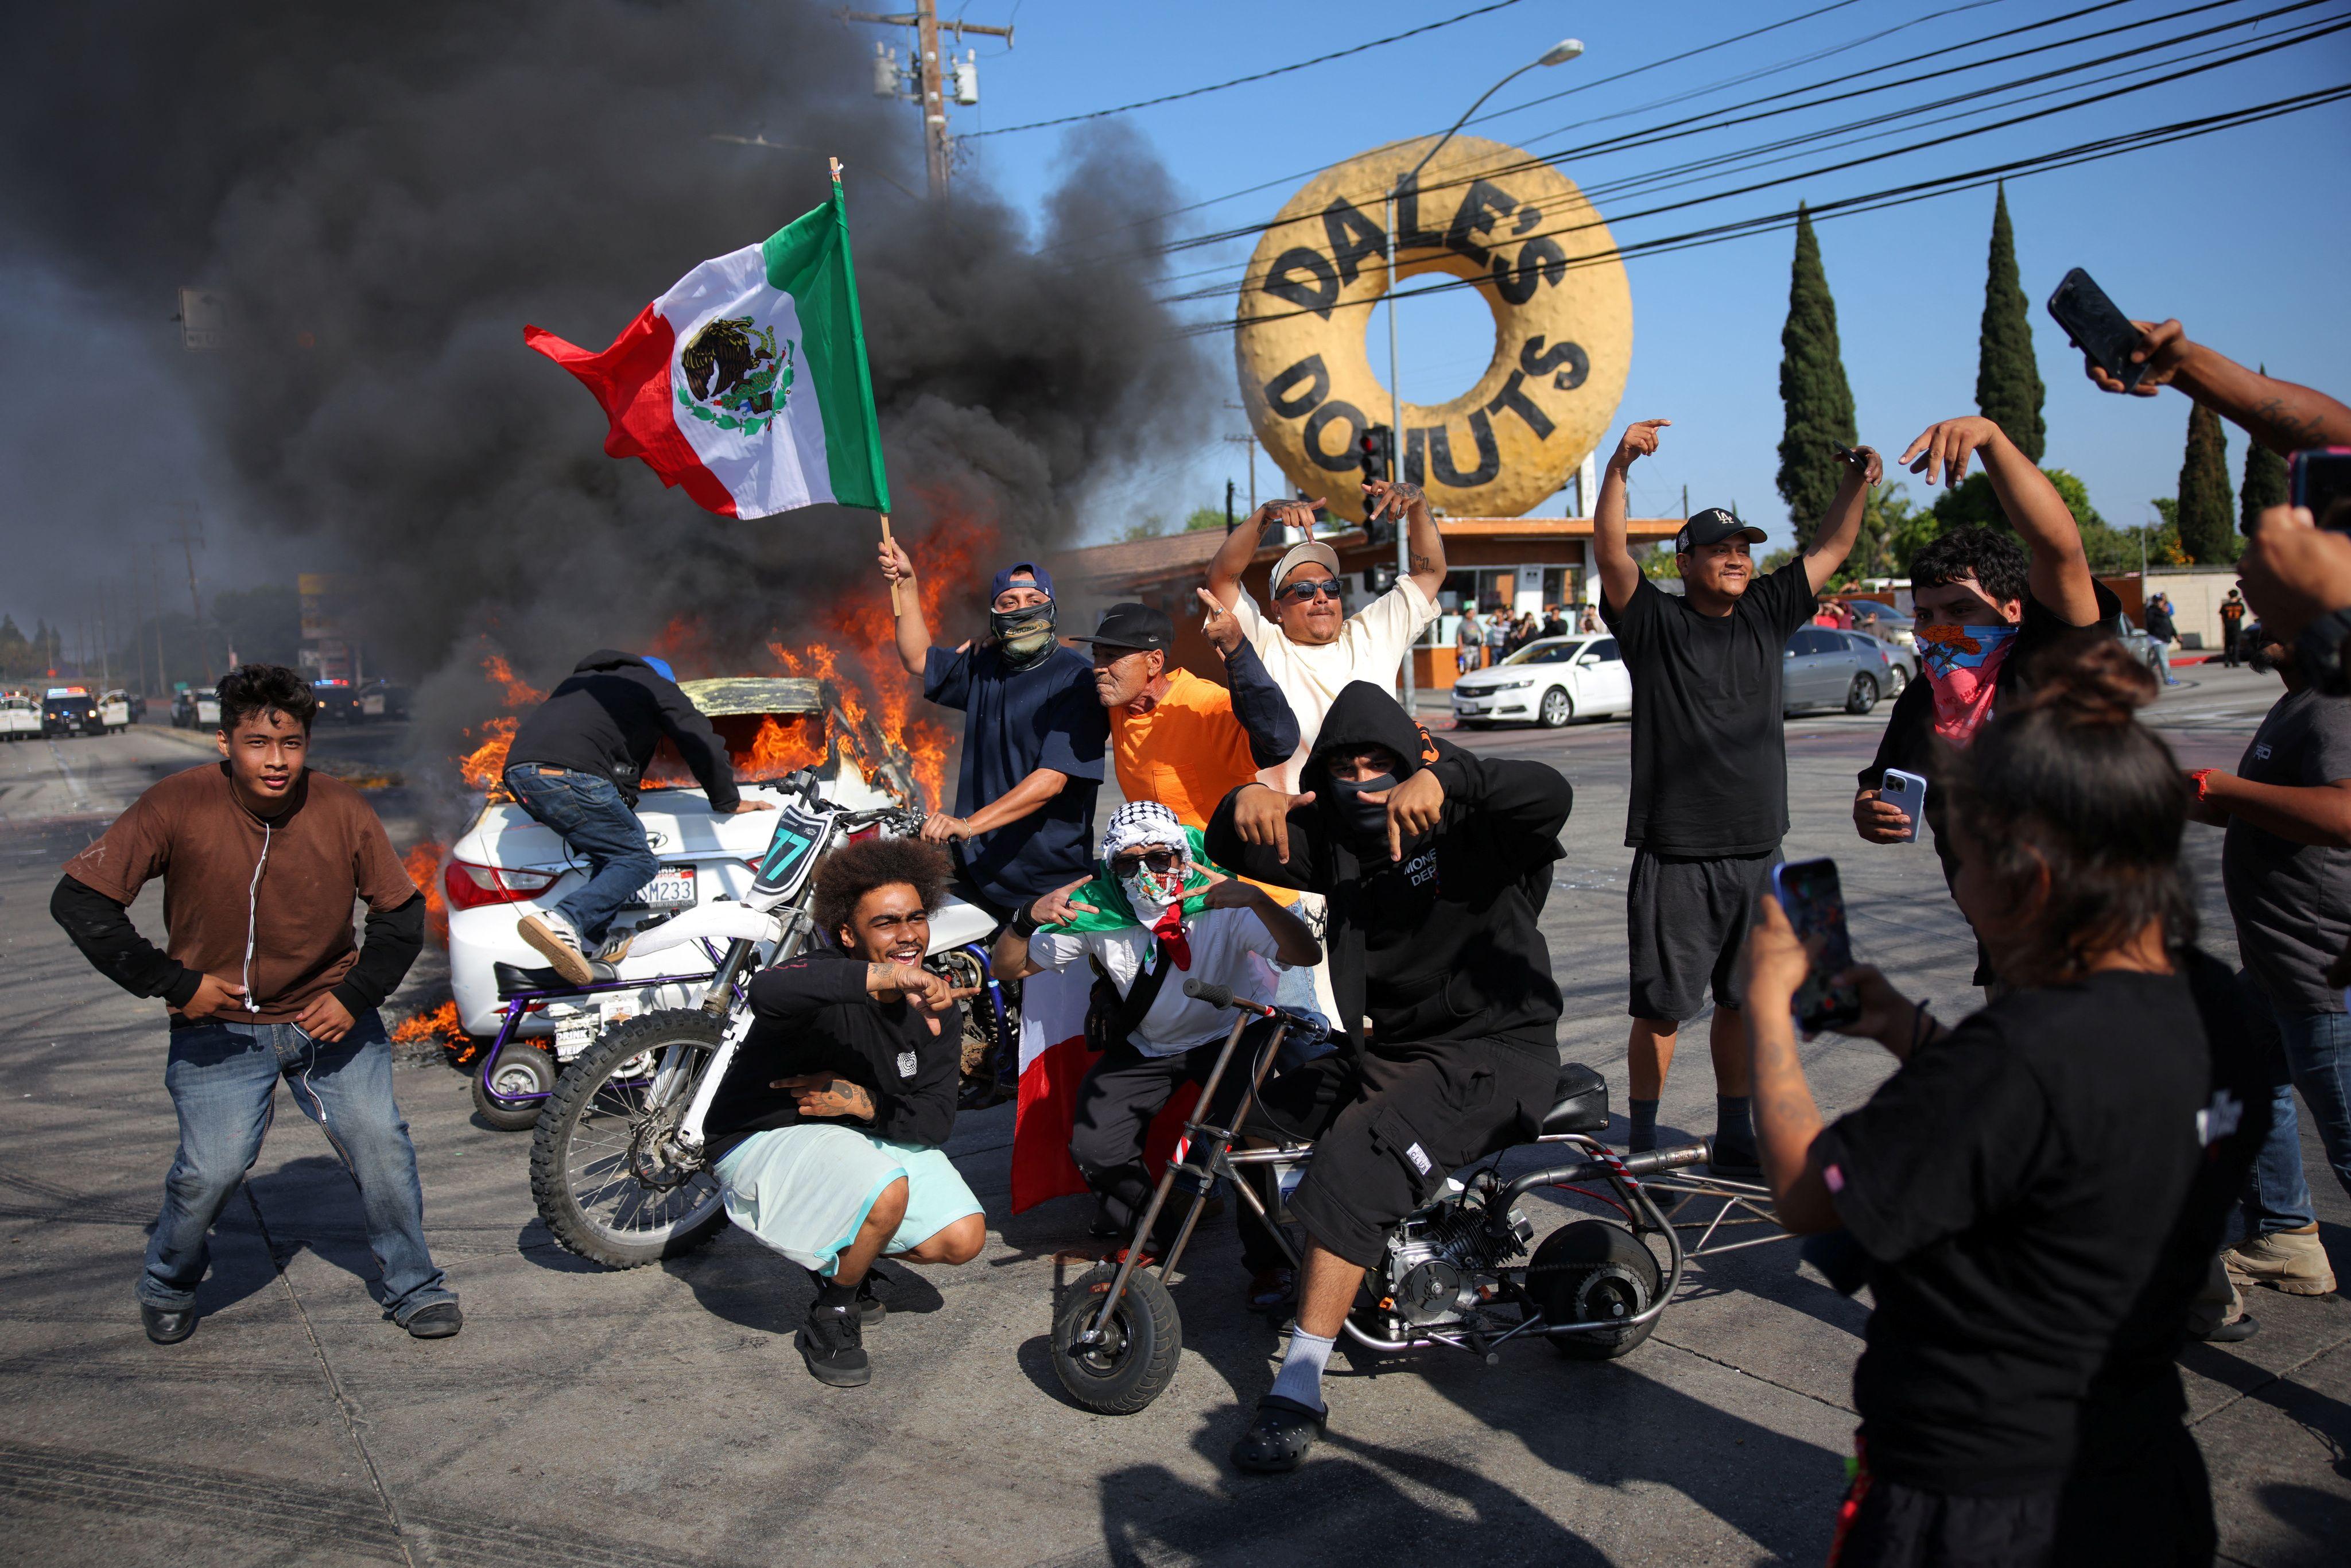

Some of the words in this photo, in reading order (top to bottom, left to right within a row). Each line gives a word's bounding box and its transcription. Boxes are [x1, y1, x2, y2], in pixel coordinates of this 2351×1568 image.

[1263, 173, 1566, 321] DALE'S
[1713, 510, 1734, 524] LA
[556, 1029, 587, 1041] DRINK
[1411, 1151, 1427, 1171] CLUB
